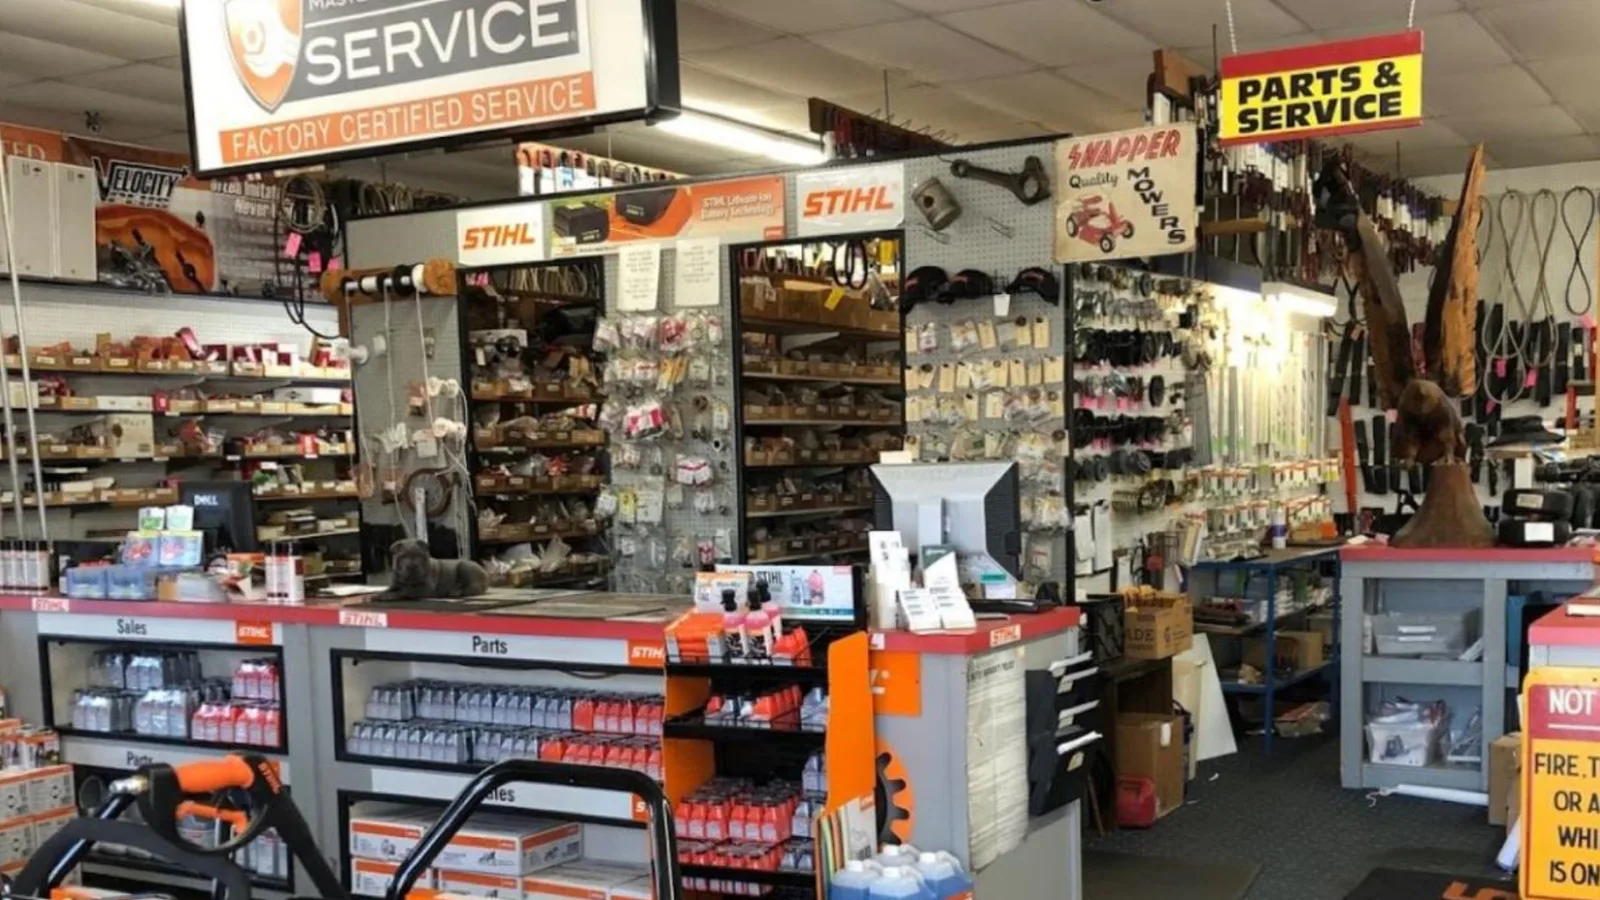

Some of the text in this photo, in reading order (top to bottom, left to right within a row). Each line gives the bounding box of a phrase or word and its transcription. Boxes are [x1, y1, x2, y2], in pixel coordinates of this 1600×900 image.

[304, 0, 569, 86] SERVICE
[1238, 61, 1402, 105] PARTS &
[232, 77, 585, 158] FACTORY CERTIFIED SERVICE
[1237, 91, 1402, 134] SERVICE
[1068, 129, 1181, 170] SNAPPER
[92, 157, 184, 201] VELOCITY
[1069, 172, 1118, 189] Quality
[803, 185, 894, 217] STIHL
[1127, 166, 1186, 244] MOWERS
[463, 222, 535, 250] STIHL
[193, 494, 219, 506] DELL
[116, 618, 147, 636] Sales
[238, 626, 270, 639] STIHL
[472, 635, 508, 655] Parts
[631, 646, 664, 659] STIH
[1549, 688, 1597, 715] NOT
[487, 786, 515, 803] ales
[1553, 790, 1582, 812] OR
[1550, 860, 1567, 883] IS
